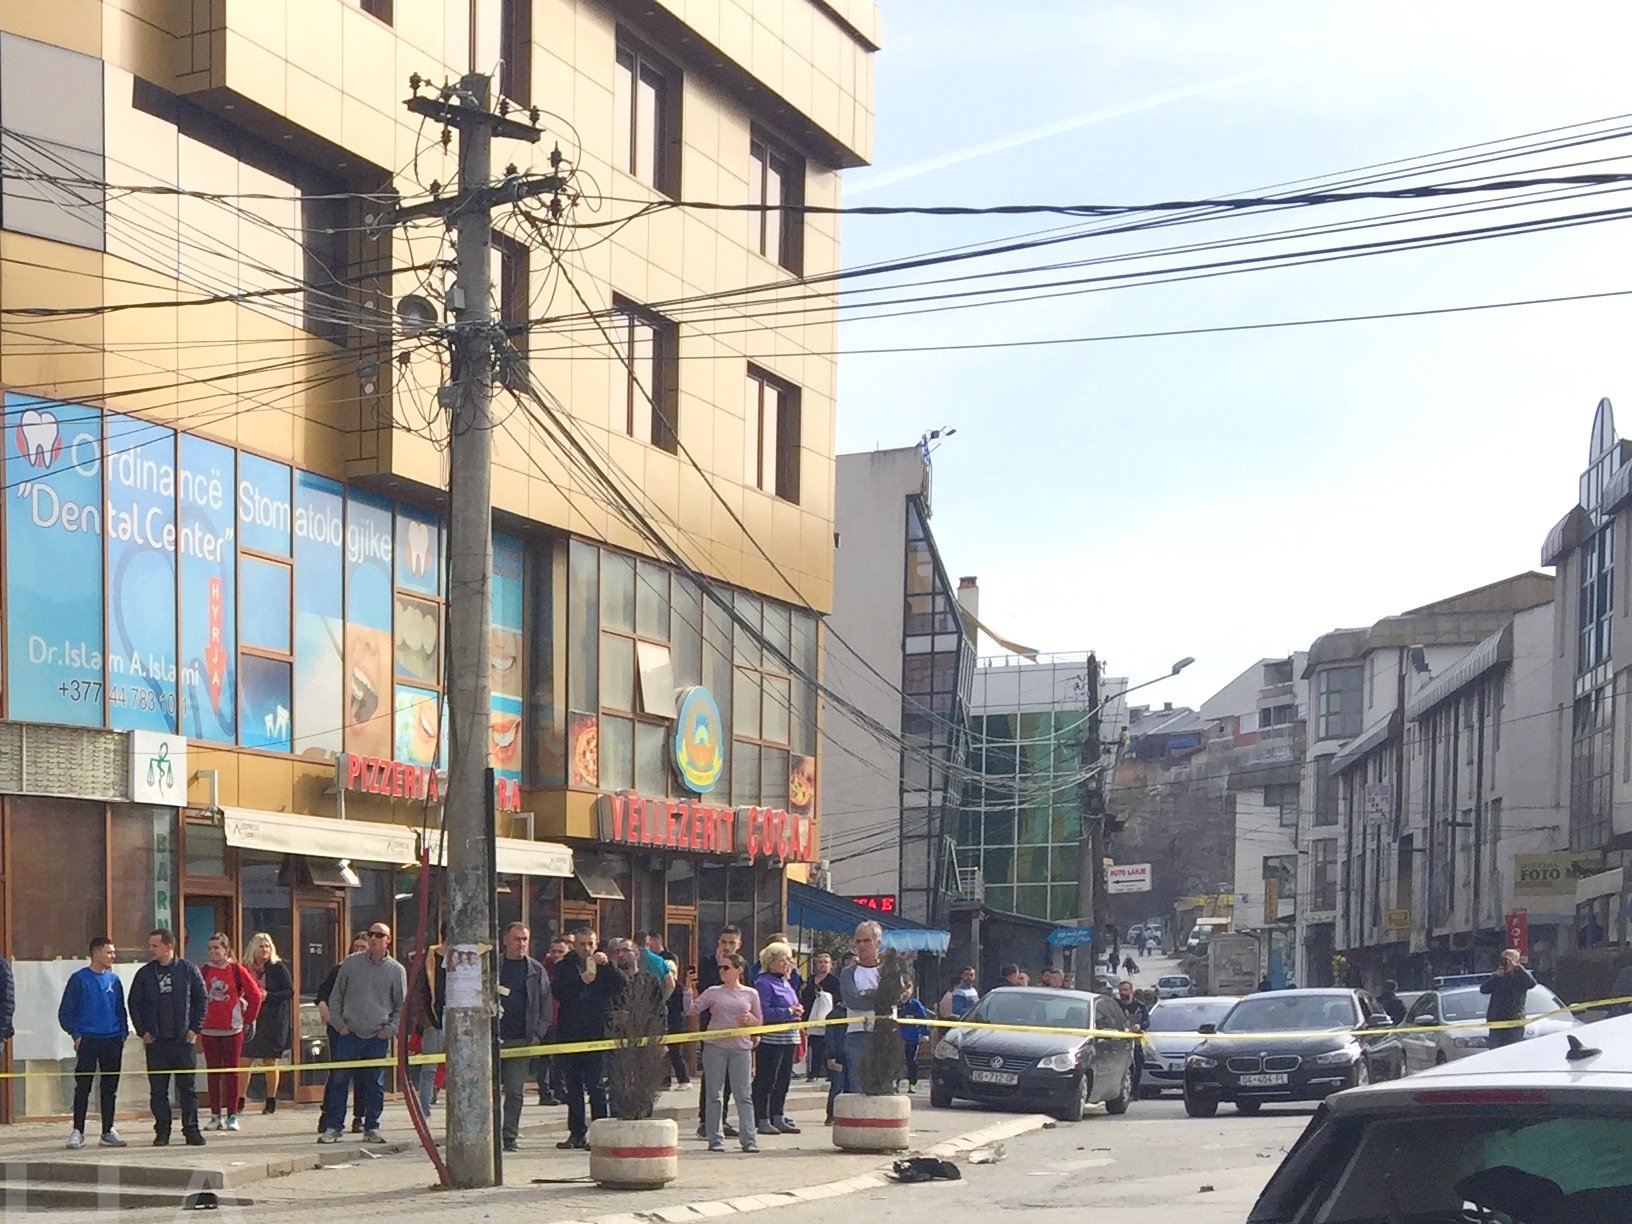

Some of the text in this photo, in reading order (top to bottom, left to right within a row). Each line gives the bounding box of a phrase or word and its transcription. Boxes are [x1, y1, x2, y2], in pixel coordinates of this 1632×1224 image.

[71, 433, 392, 564] Ordinancë Stomatologjike
[211, 584, 221, 685] HYRJA
[347, 753, 439, 802] PIZZERIA
[1520, 868, 1560, 881] FOTO
[1511, 917, 1521, 953] FOT
